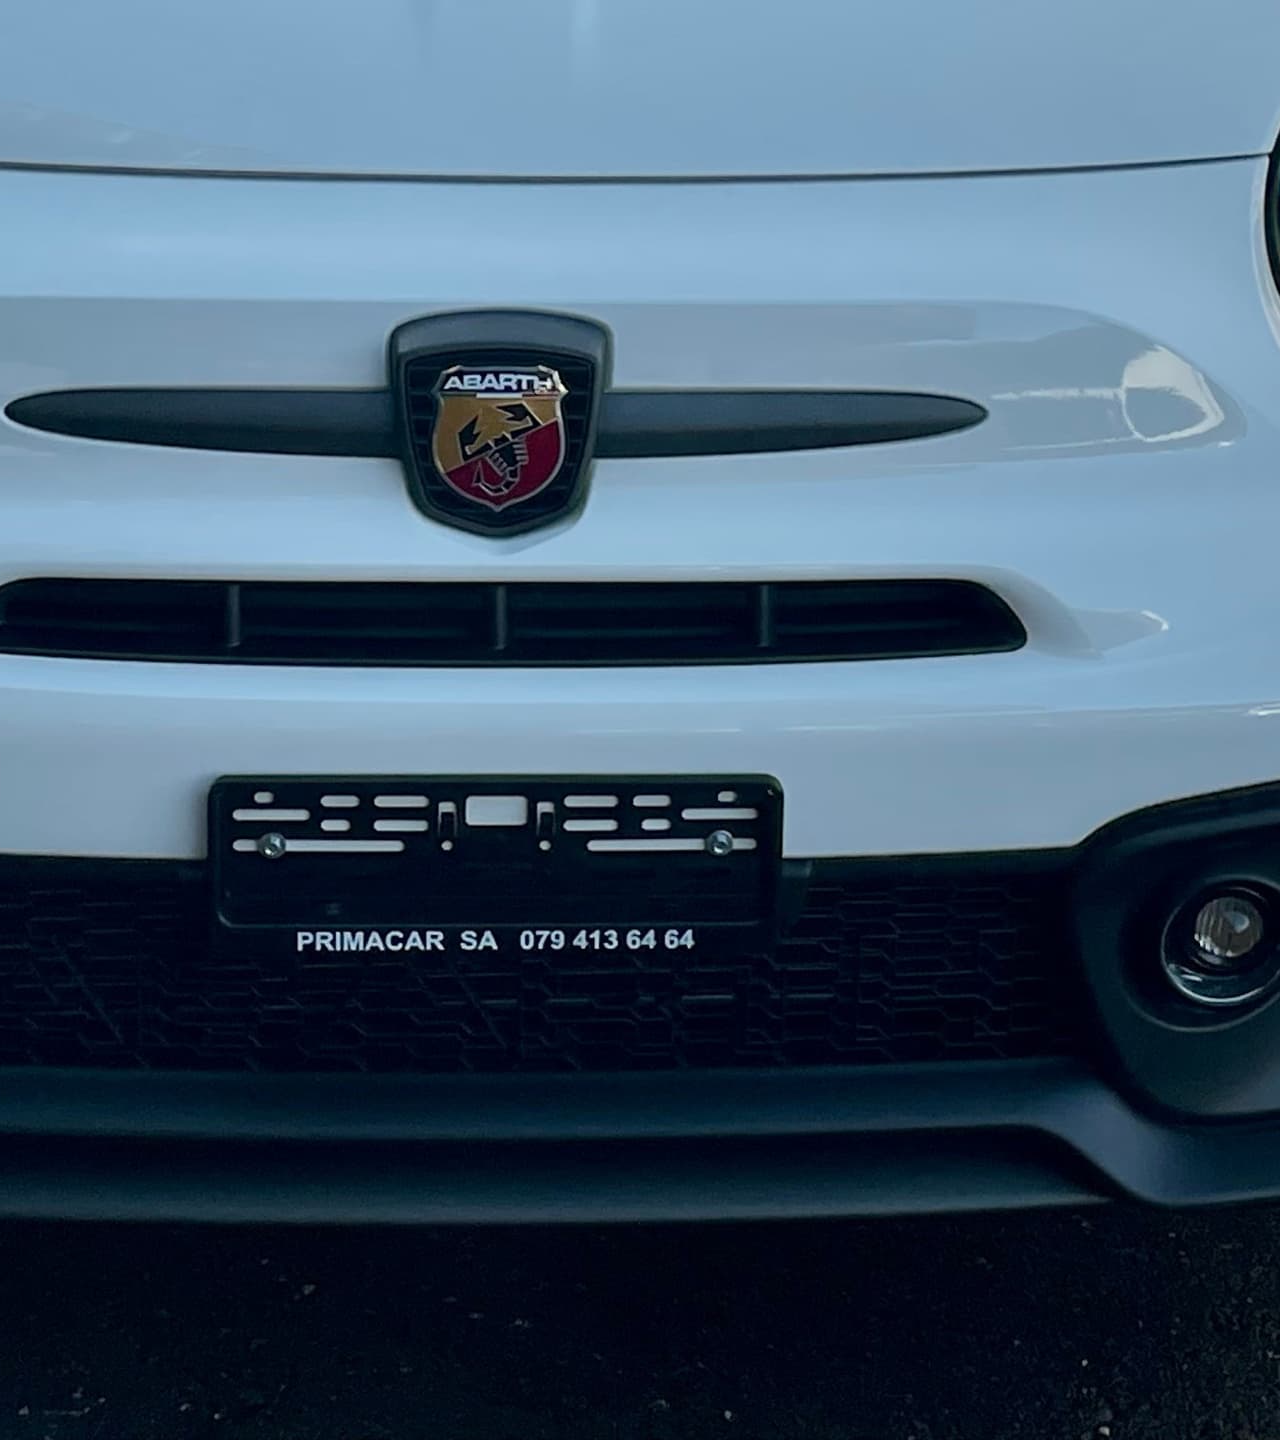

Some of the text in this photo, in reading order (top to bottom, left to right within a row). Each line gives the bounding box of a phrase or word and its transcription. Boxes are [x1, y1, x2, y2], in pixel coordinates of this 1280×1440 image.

[443, 373, 553, 391] ABARTH
[296, 929, 695, 951] PRIMACAR SA 079 413 64 64
